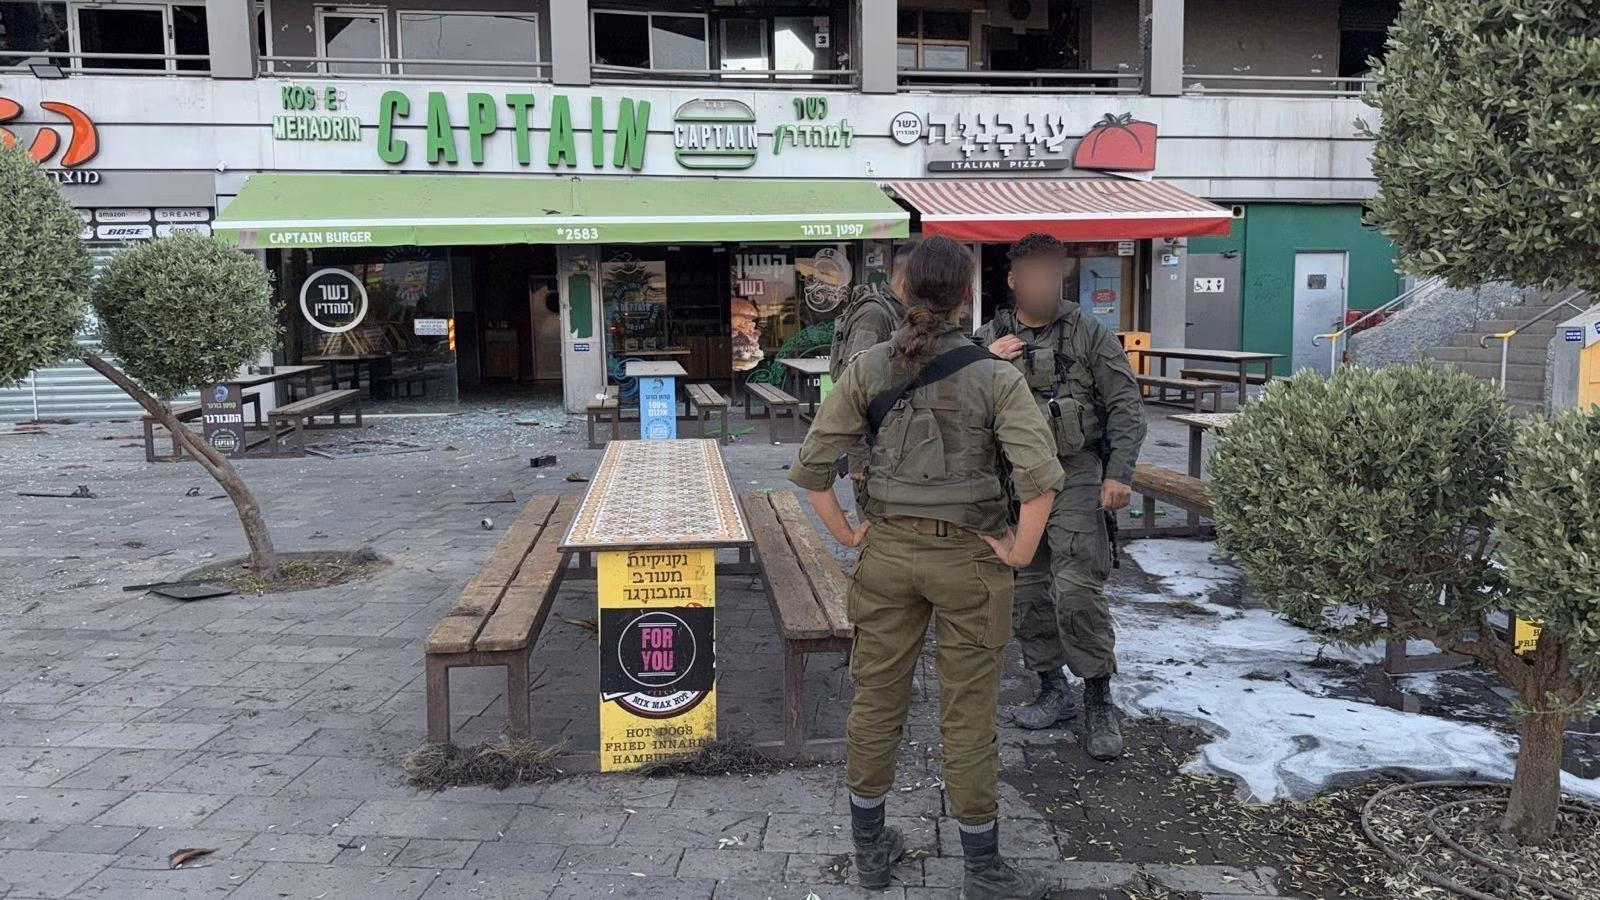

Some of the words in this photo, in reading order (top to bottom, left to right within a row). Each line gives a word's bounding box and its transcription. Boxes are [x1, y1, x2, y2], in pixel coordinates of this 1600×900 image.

[792, 96, 829, 121] כשר
[272, 115, 361, 141] MEHADRIN
[377, 91, 651, 170] CAPTAIN
[896, 119, 918, 128] כשר
[673, 124, 758, 150] CAPTAIN
[951, 160, 1000, 169] ITALIAN
[1010, 160, 1046, 169] PIZZA
[43, 170, 100, 184] מוצר
[101, 228, 149, 236] BOSE
[269, 231, 323, 244] CAPTAIN
[326, 230, 373, 243] BURGER
[800, 224, 832, 237] בורגר
[836, 223, 864, 239] קפטן
[735, 254, 787, 279] קפטן
[318, 285, 349, 300] כשר
[737, 279, 764, 295] בשר
[315, 302, 354, 317] למהדרין
[203, 413, 241, 424] המבורגר
[627, 553, 688, 569] נקניקיות
[632, 570, 683, 584] מעורב
[623, 586, 692, 601] המבורגר
[641, 627, 674, 649] FOR
[641, 650, 674, 672] YOU
[632, 696, 649, 708] MIX
[652, 700, 672, 709] MAX
[673, 692, 690, 705] HOT
[626, 728, 653, 738] HOT
[659, 725, 694, 737] DOGS
[605, 741, 647, 752] FRIED
